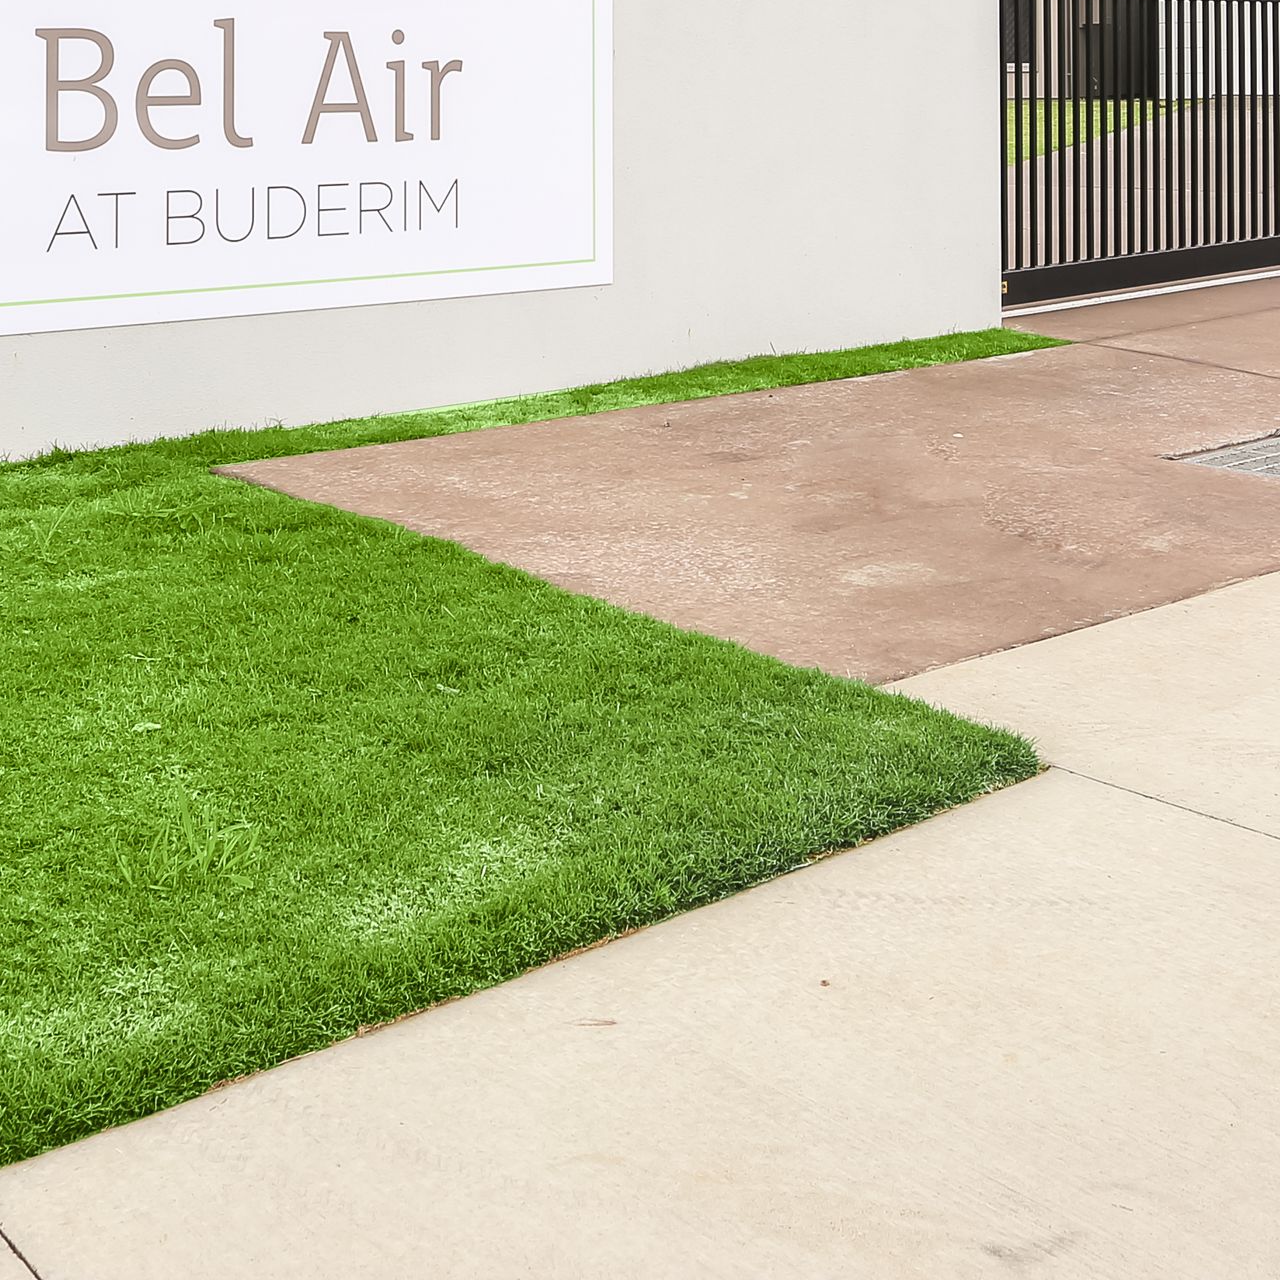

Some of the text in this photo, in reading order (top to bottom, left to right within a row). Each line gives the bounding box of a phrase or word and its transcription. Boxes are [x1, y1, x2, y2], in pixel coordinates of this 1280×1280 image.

[34, 17, 464, 153] Bel Air
[45, 178, 459, 253] AT BUDERIM
